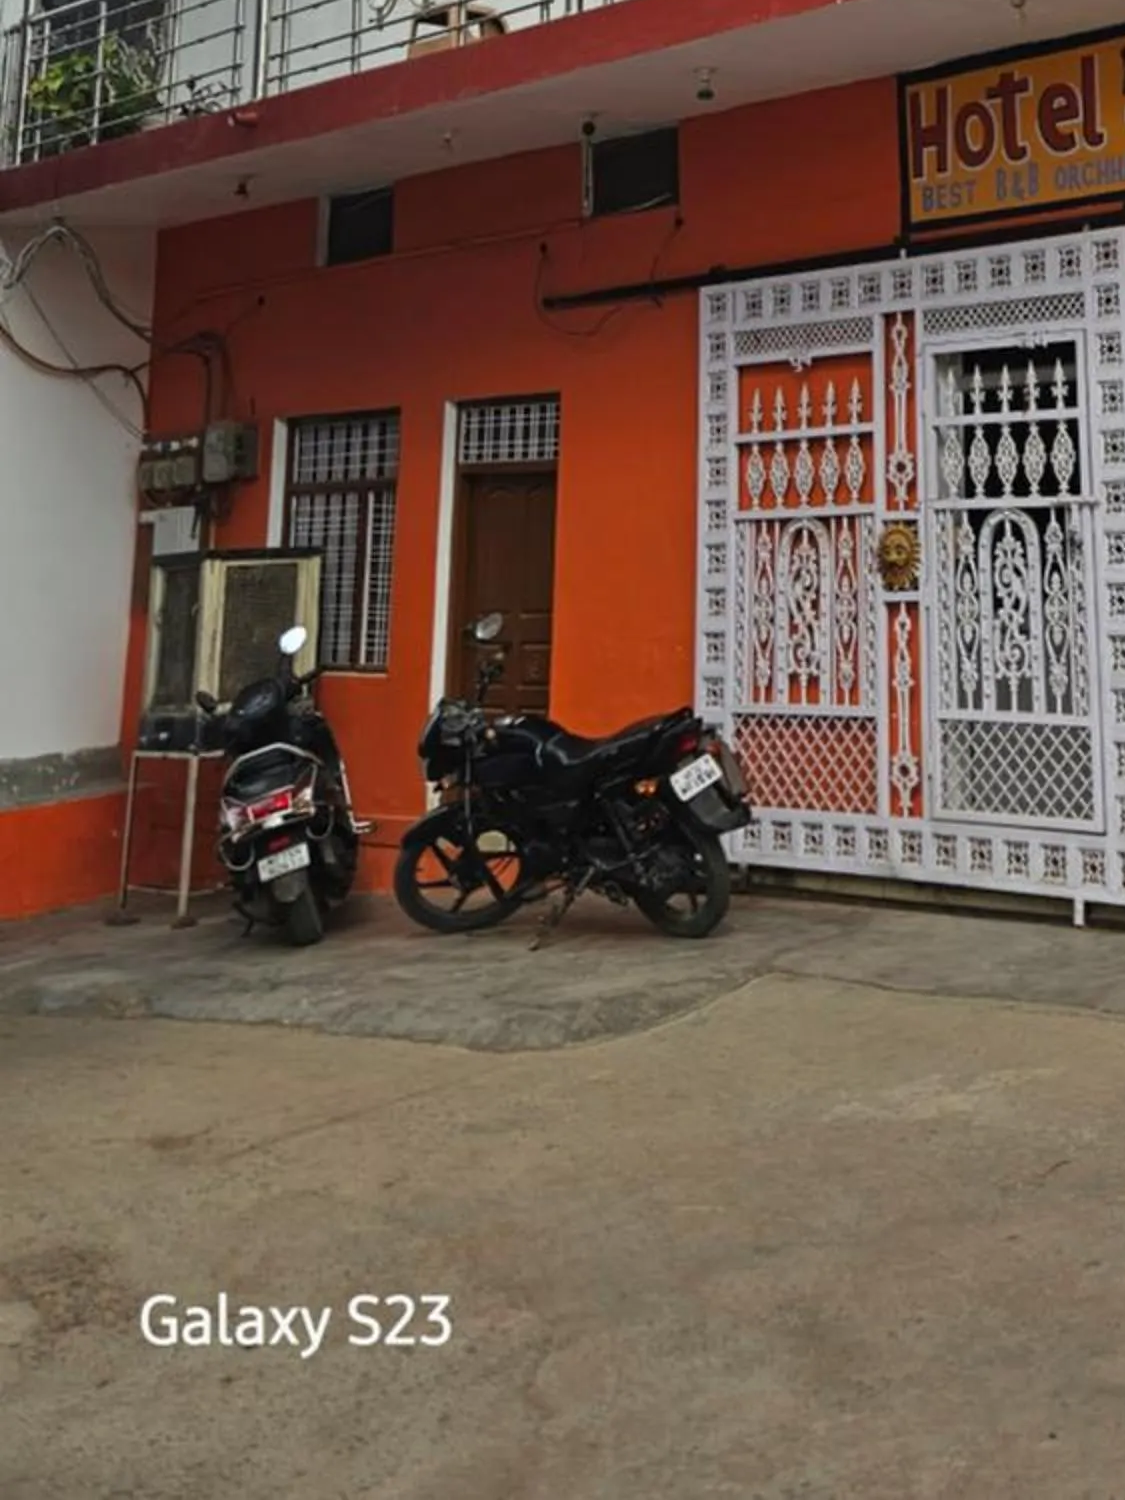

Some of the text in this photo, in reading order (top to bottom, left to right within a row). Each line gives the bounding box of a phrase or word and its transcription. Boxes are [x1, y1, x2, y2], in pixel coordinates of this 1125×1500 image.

[910, 56, 1105, 182] Hotel
[921, 180, 977, 212] BEST
[995, 161, 1040, 200] B&B
